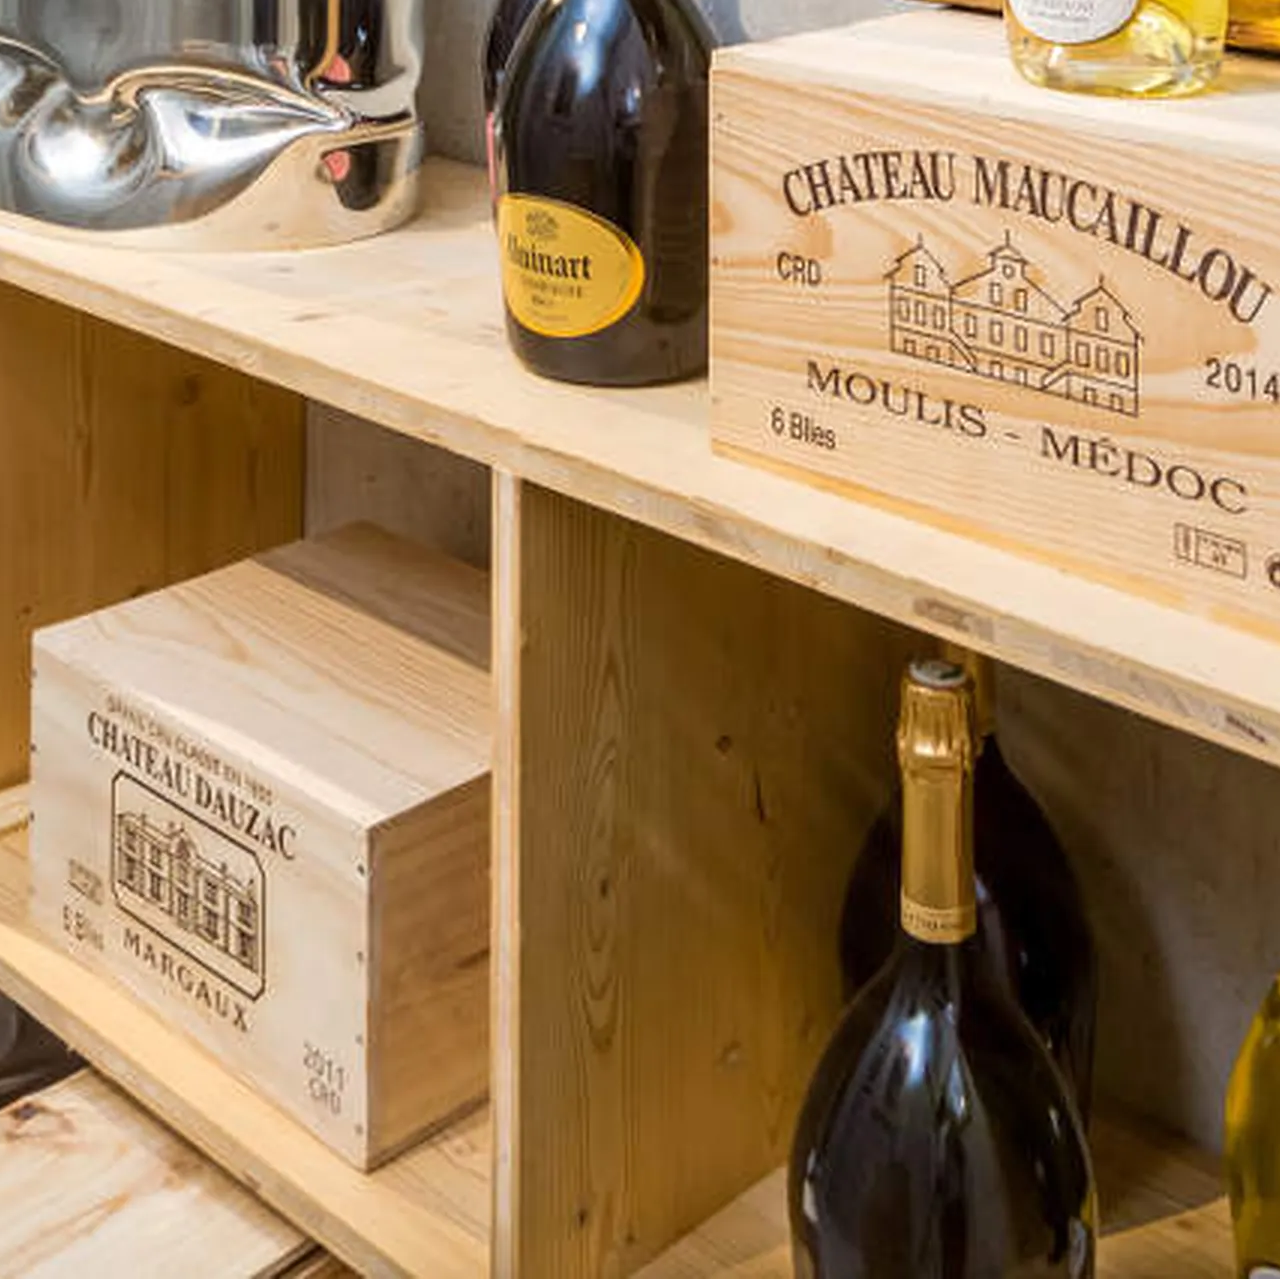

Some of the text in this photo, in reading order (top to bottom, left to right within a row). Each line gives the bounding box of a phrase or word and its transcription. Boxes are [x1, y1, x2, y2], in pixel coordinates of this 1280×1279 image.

[507, 231, 592, 280] Ruinart
[777, 251, 821, 286] CRD
[783, 150, 1272, 324] CHATEAU MAUCAILLOU
[1204, 356, 1280, 403] 2014
[771, 407, 785, 436] 6
[806, 360, 987, 438] MOULIS
[1040, 425, 1248, 514] MÉDOC
[87, 711, 297, 860] CHATEAU DAUZAC
[123, 927, 249, 1032] MARGAUX
